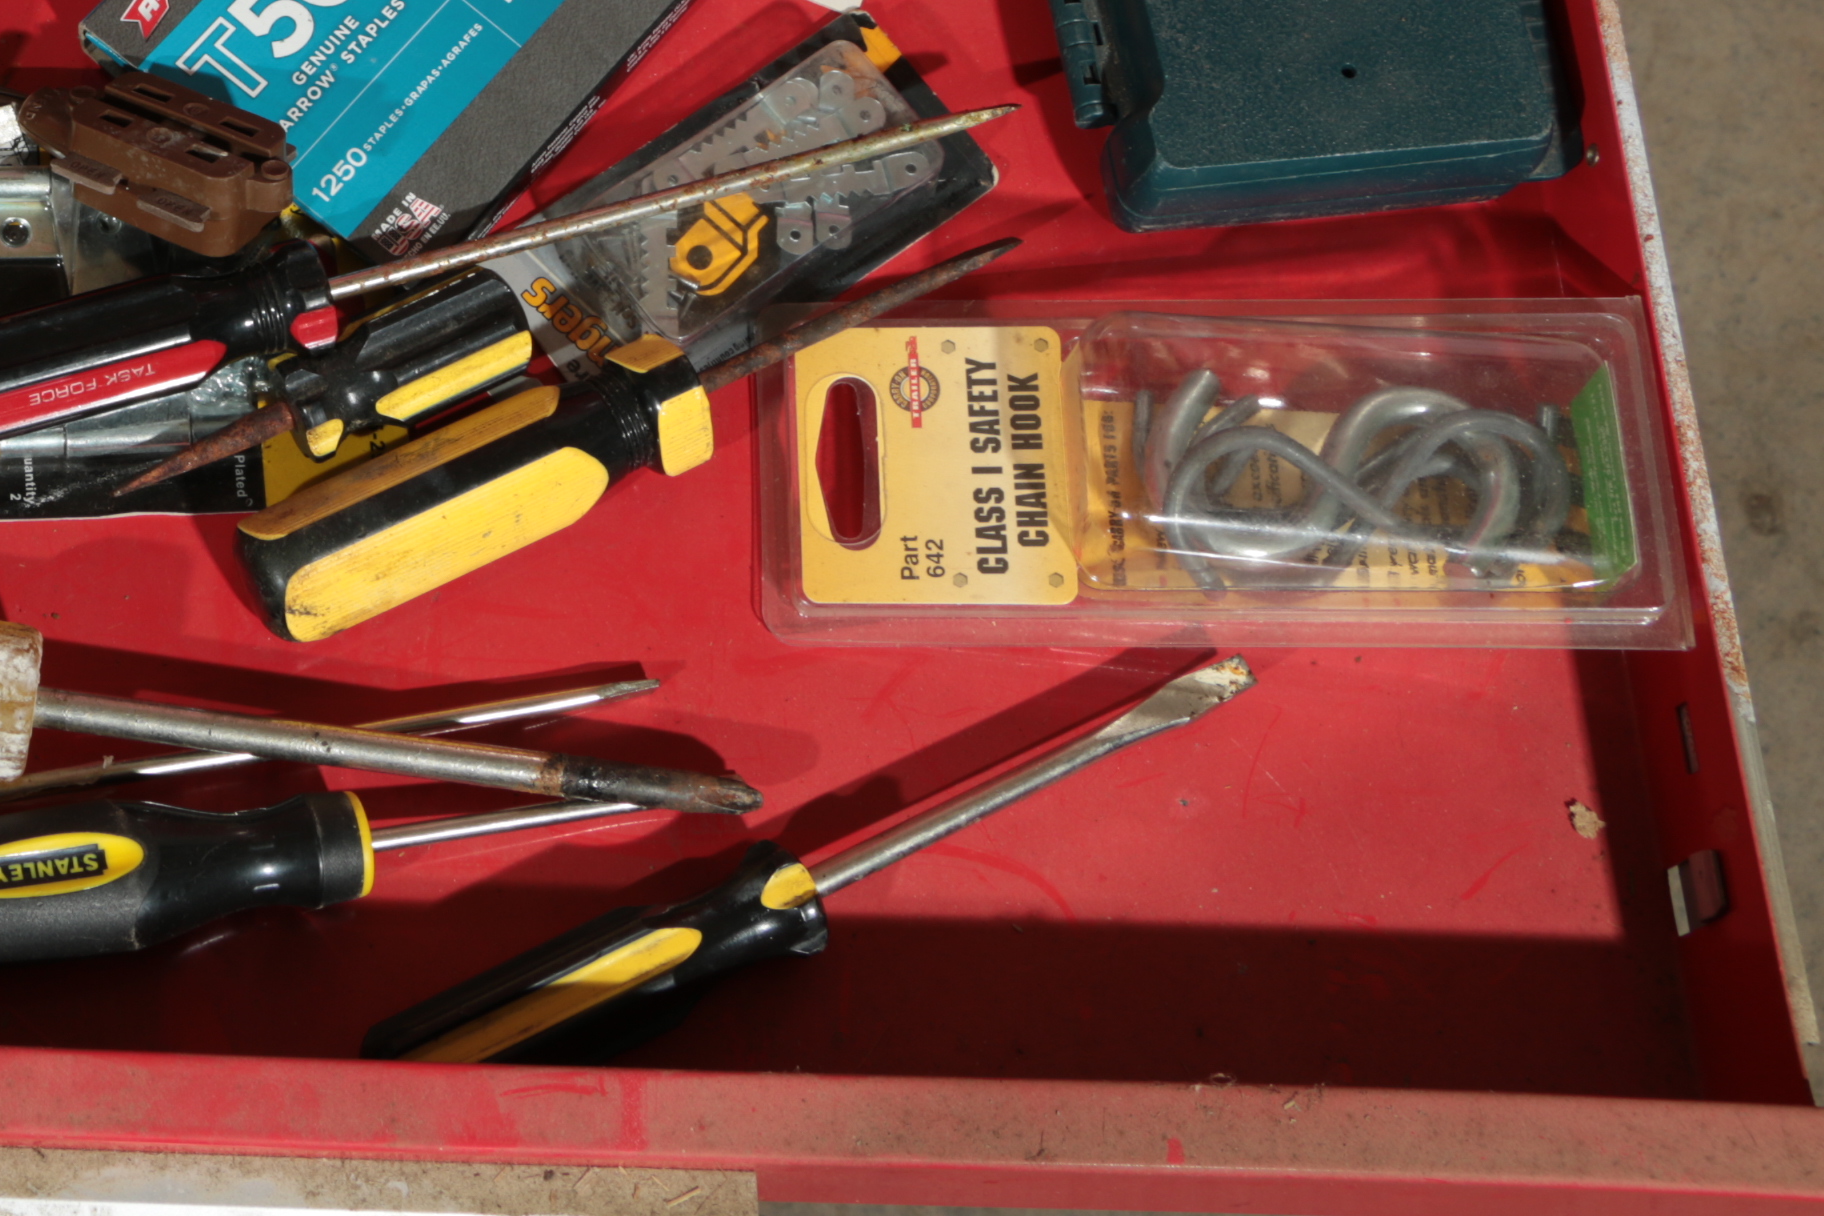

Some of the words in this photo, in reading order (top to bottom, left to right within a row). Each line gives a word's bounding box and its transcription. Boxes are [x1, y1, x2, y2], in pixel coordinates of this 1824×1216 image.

[291, 14, 360, 86] GENUINE
[311, 146, 369, 203] 1250
[378, 196, 442, 257] USA
[28, 377, 100, 408] FORCE
[109, 363, 156, 386] TASK
[908, 358, 921, 419] TRAILER
[964, 356, 1003, 454] SAFETY
[1006, 371, 1044, 451] HOOK
[9, 492, 22, 503] 2
[233, 454, 246, 499] Plated
[1012, 462, 1051, 548] CHAIN
[899, 534, 921, 581] Part
[925, 538, 947, 579] 642
[972, 486, 1010, 575] CLASS
